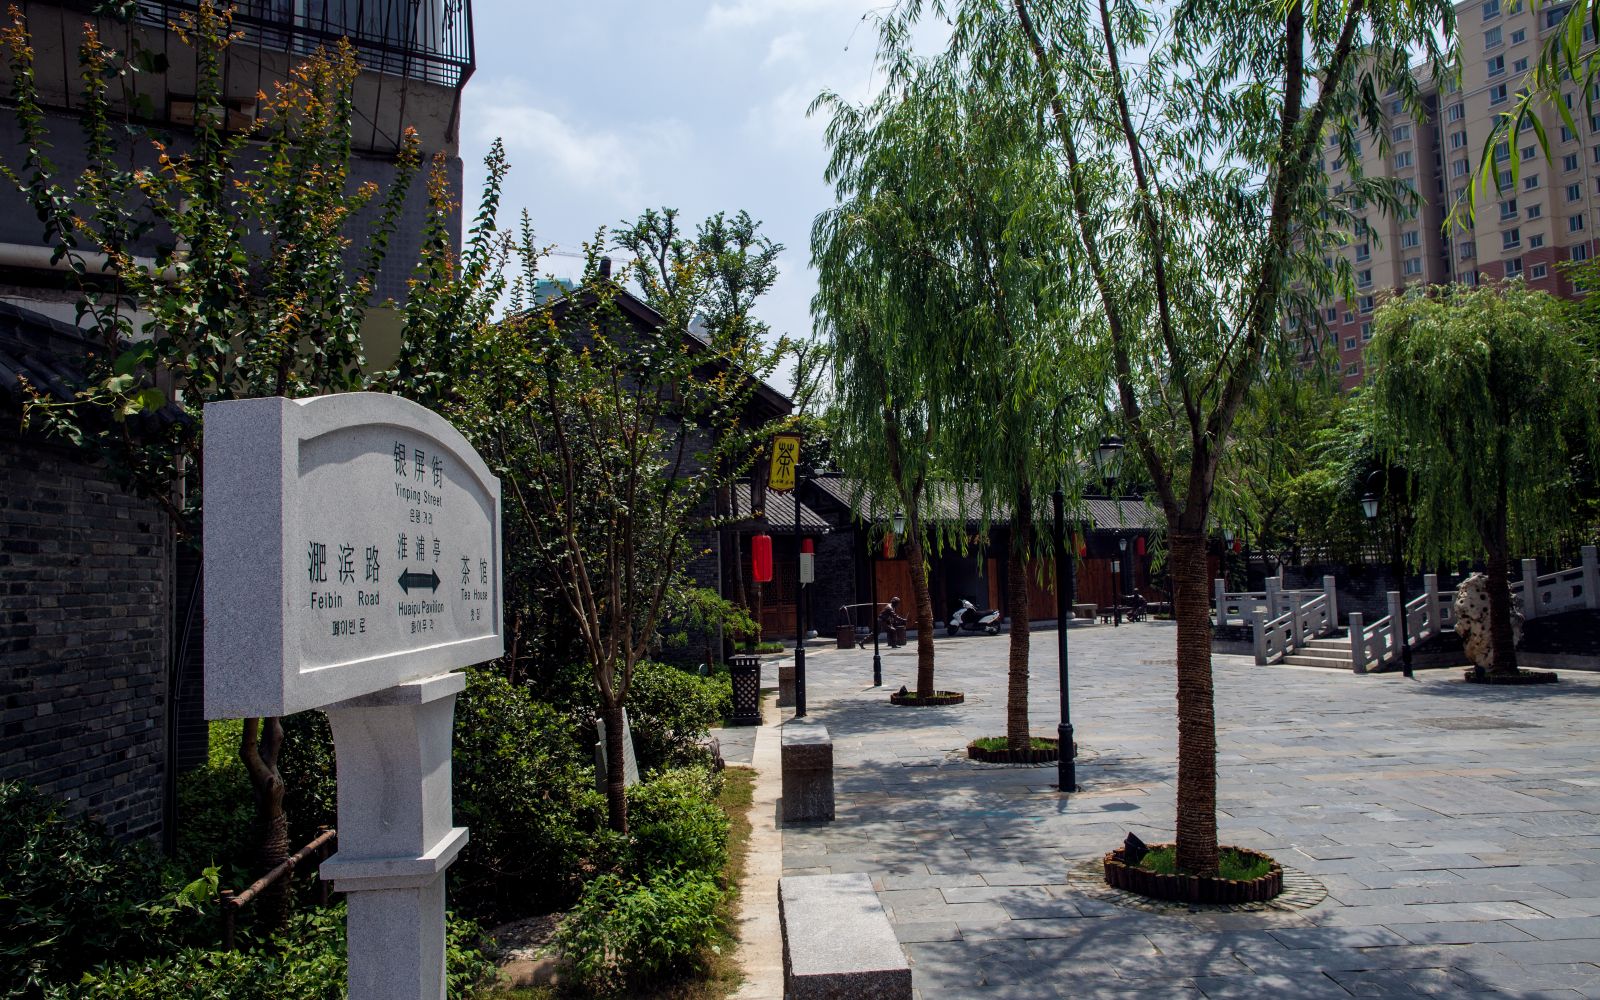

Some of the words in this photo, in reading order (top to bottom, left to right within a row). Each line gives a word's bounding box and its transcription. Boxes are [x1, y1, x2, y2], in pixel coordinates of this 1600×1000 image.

[394, 440, 443, 489] 银屏街
[776, 442, 795, 478] 茶
[395, 481, 421, 505] Yinping
[423, 490, 442, 507] Street
[307, 540, 381, 585] 淝滨路
[397, 532, 441, 563] 淮浦亭
[461, 555, 488, 586] 茶馆
[311, 590, 343, 610] Feibin
[358, 590, 380, 607] Road
[398, 600, 421, 618] Huaipu
[421, 599, 445, 614] Pavilion
[461, 588, 471, 601] Tea
[473, 588, 488, 601] House
